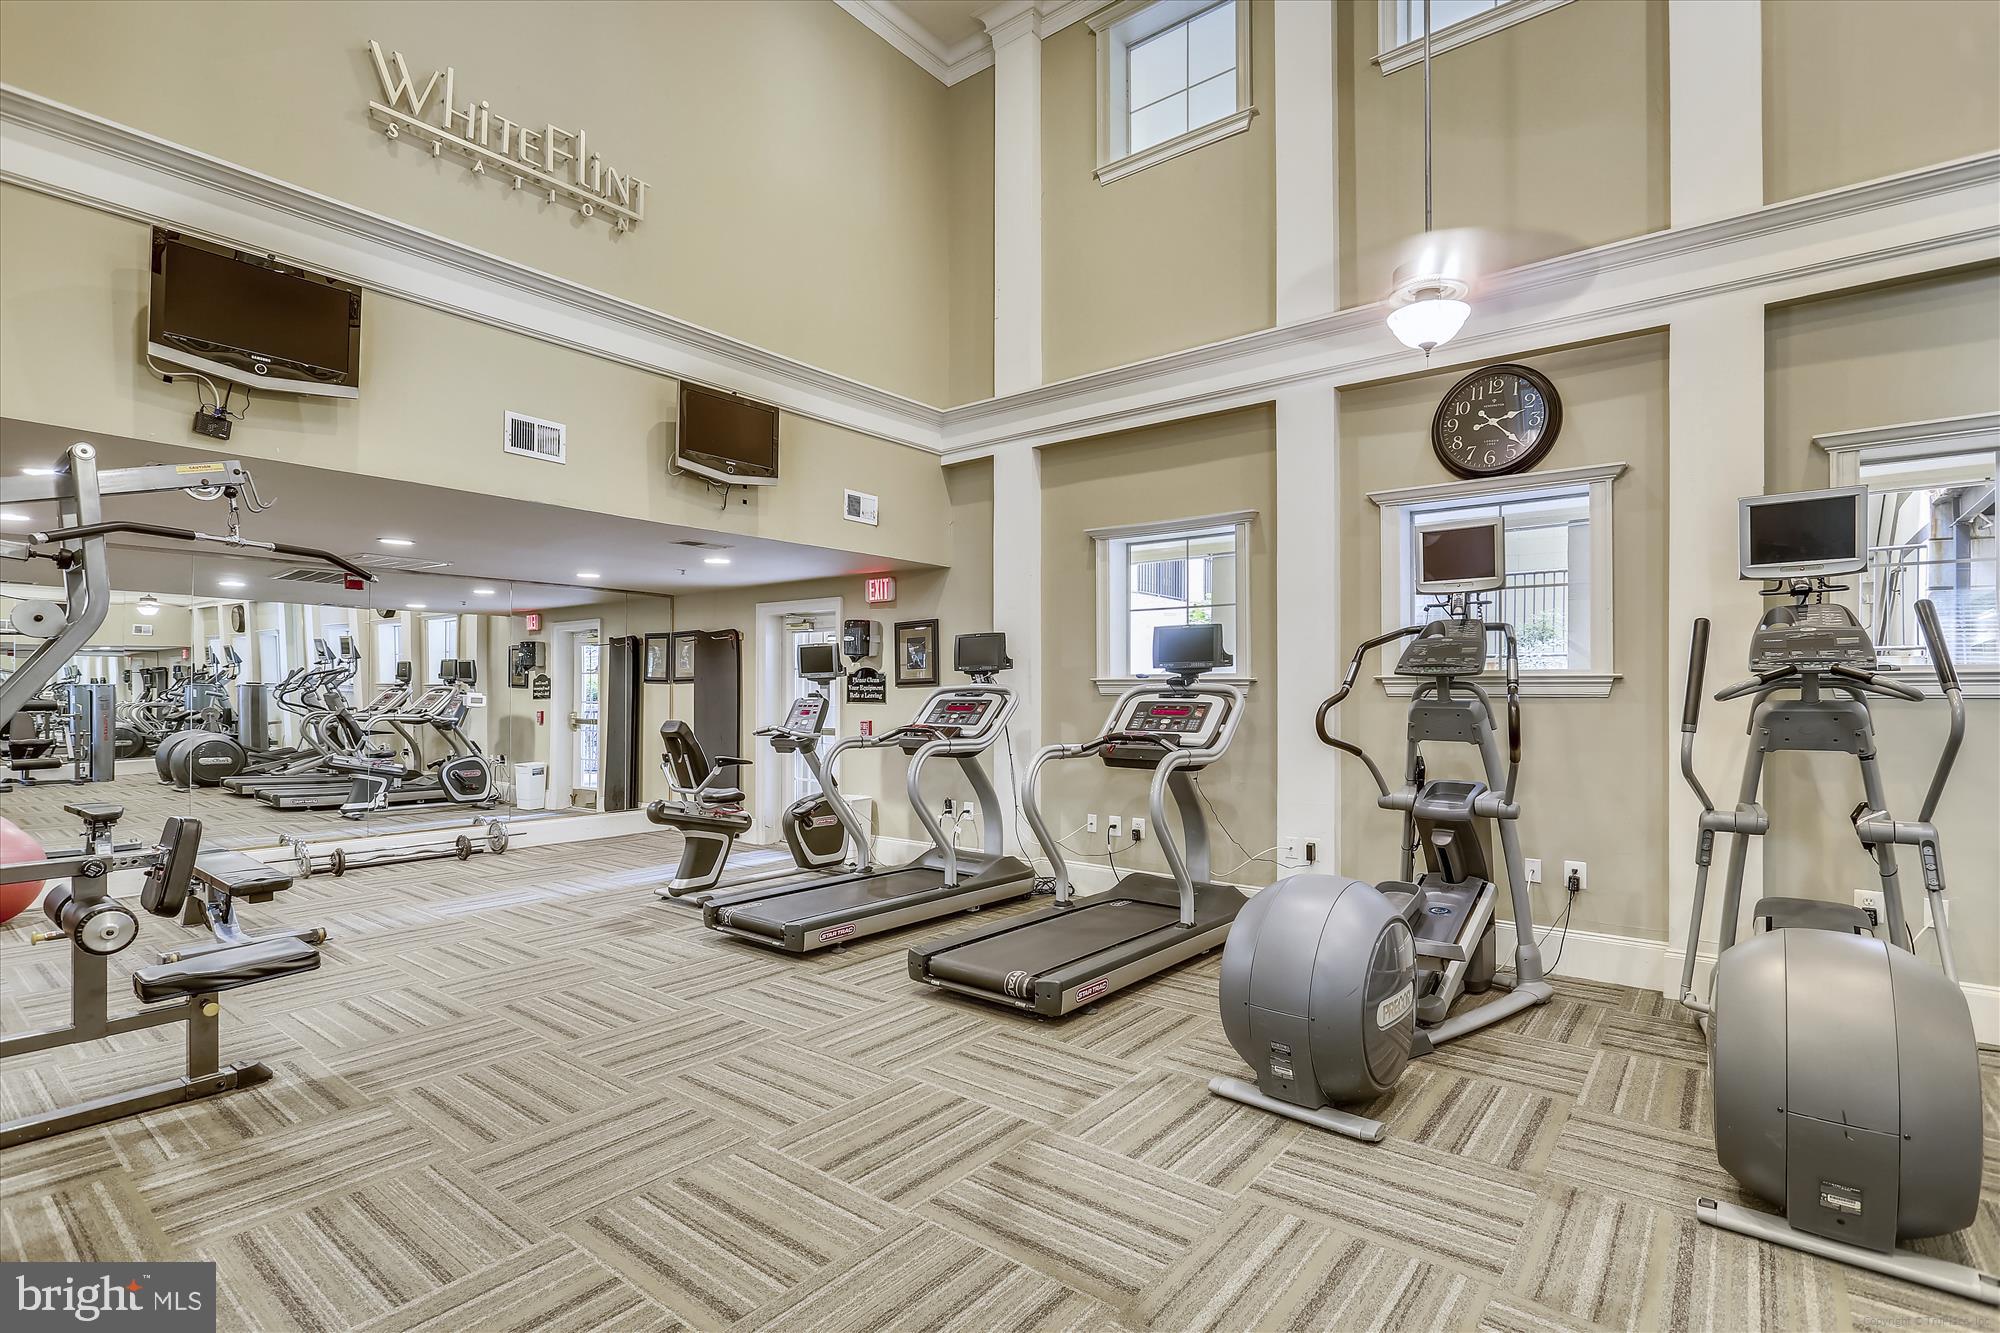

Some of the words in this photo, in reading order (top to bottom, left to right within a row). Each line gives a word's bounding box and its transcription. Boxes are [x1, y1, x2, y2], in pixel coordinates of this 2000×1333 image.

[386, 122, 629, 232] STATION
[1471, 386, 1483, 400] 11
[1488, 379, 1504, 394] 12
[1513, 381, 1518, 396] 1
[1524, 393, 1536, 408] 2
[1455, 401, 1470, 416] 10
[1447, 419, 1459, 433] 9
[1529, 411, 1540, 426] 3
[1452, 435, 1463, 449] 8
[1520, 429, 1531, 444] 4
[1466, 445, 1477, 460] 7
[1484, 450, 1495, 464] 6
[1506, 444, 1517, 459] 5
[869, 578, 889, 600] EXIT
[821, 931, 838, 939] STAR
[838, 927, 854, 935] TRAC
[1077, 988, 1092, 999] STAR
[1092, 982, 1107, 993] TRAC
